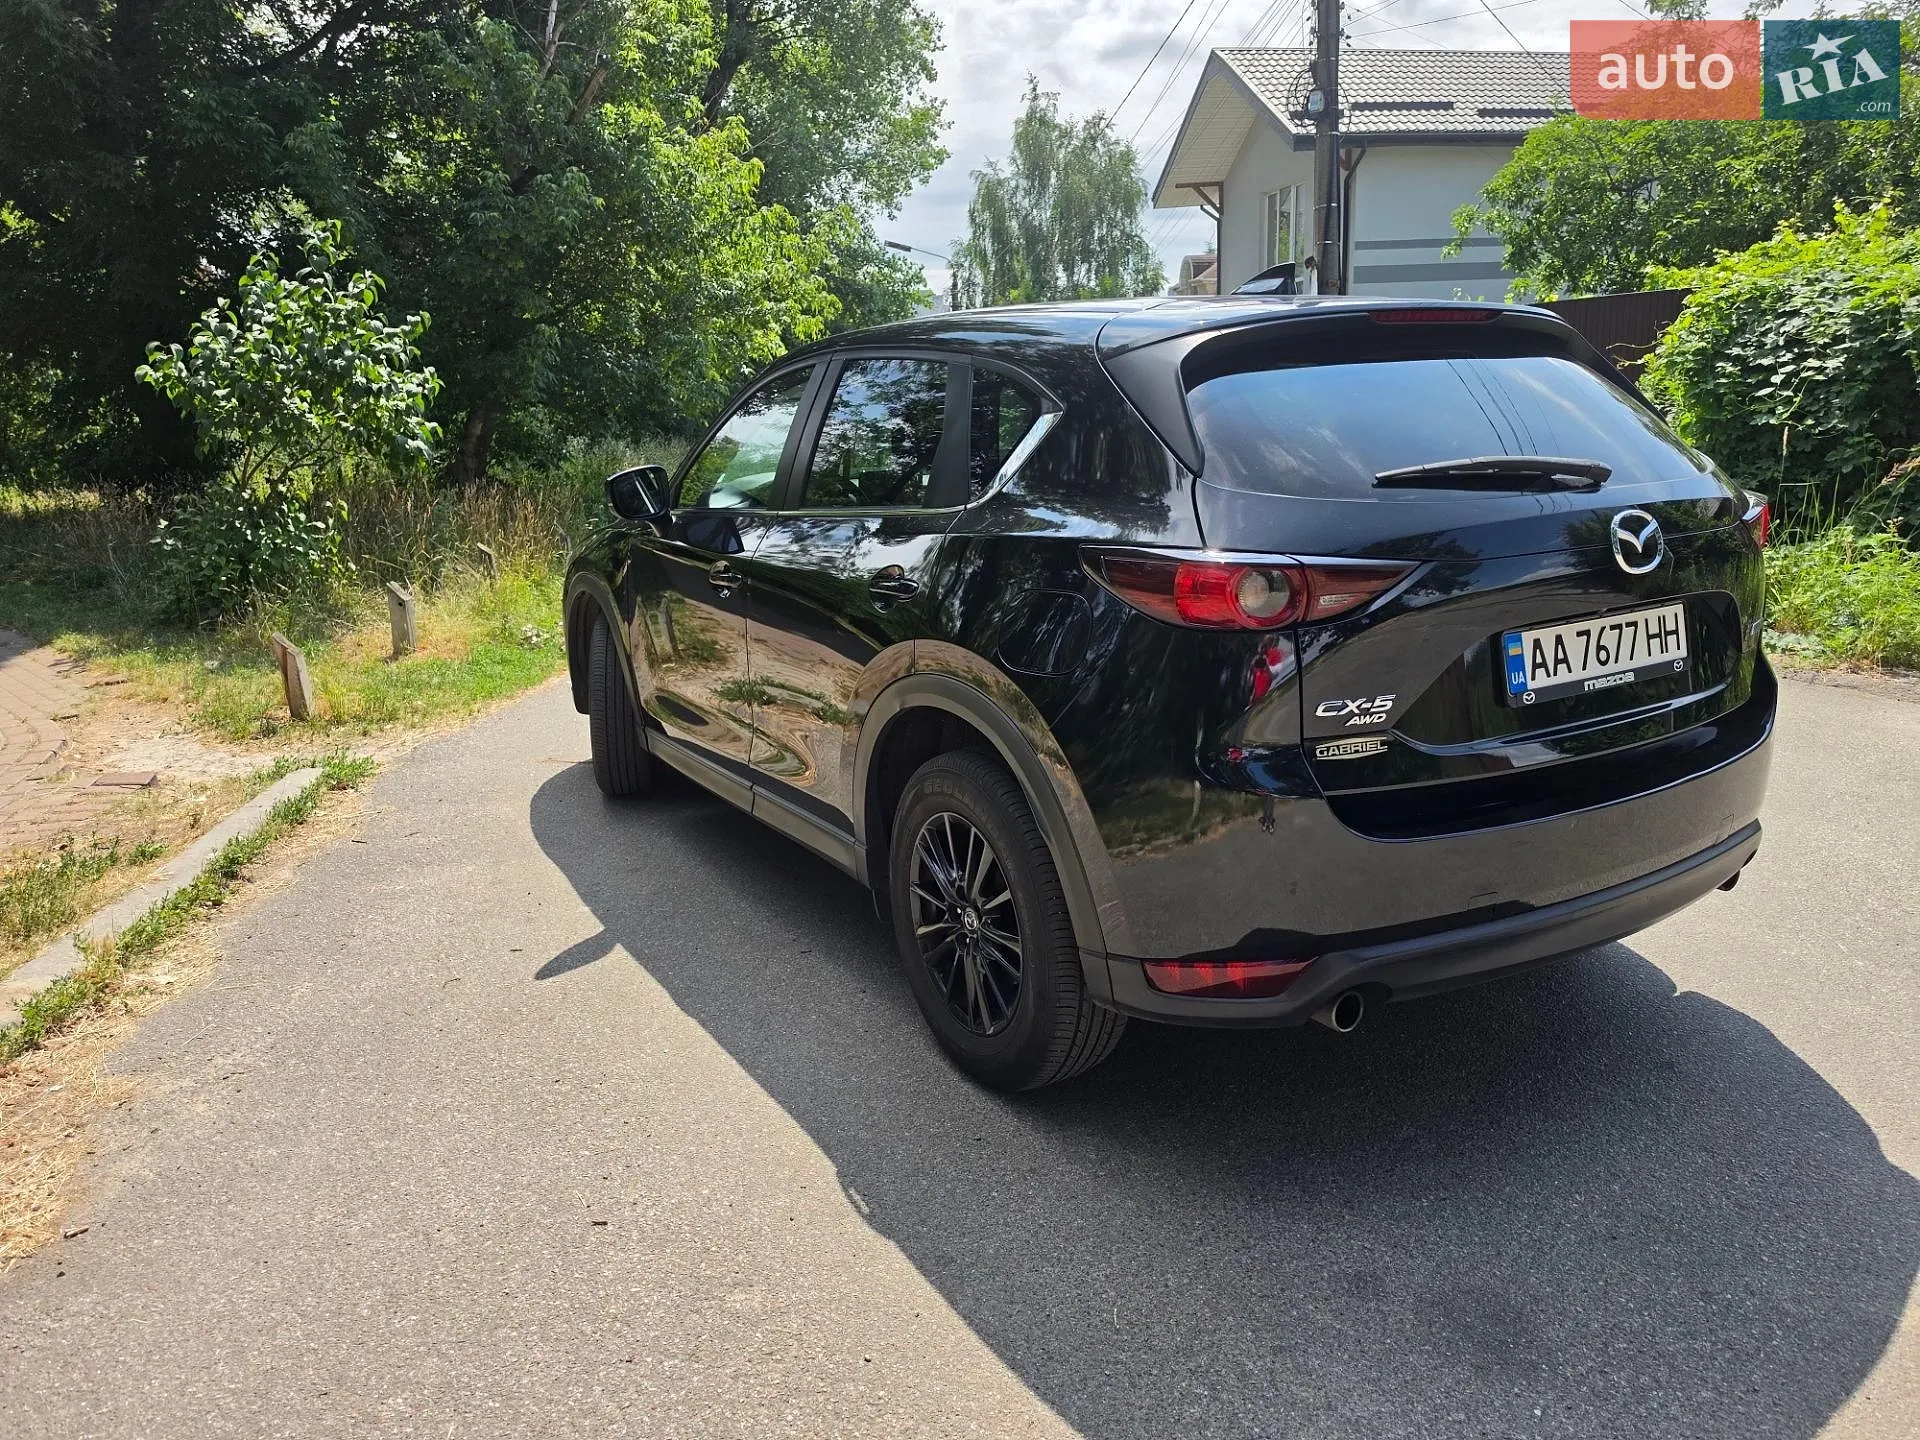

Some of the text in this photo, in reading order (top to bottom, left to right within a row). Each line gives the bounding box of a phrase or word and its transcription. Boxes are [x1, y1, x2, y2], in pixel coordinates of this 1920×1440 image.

[1531, 612, 1681, 682] AA 7677 HH
[1512, 672, 1526, 685] UA
[1315, 694, 1397, 717] CX-5
[1344, 713, 1387, 727] AWD
[1315, 740, 1388, 758] GABRIEL
